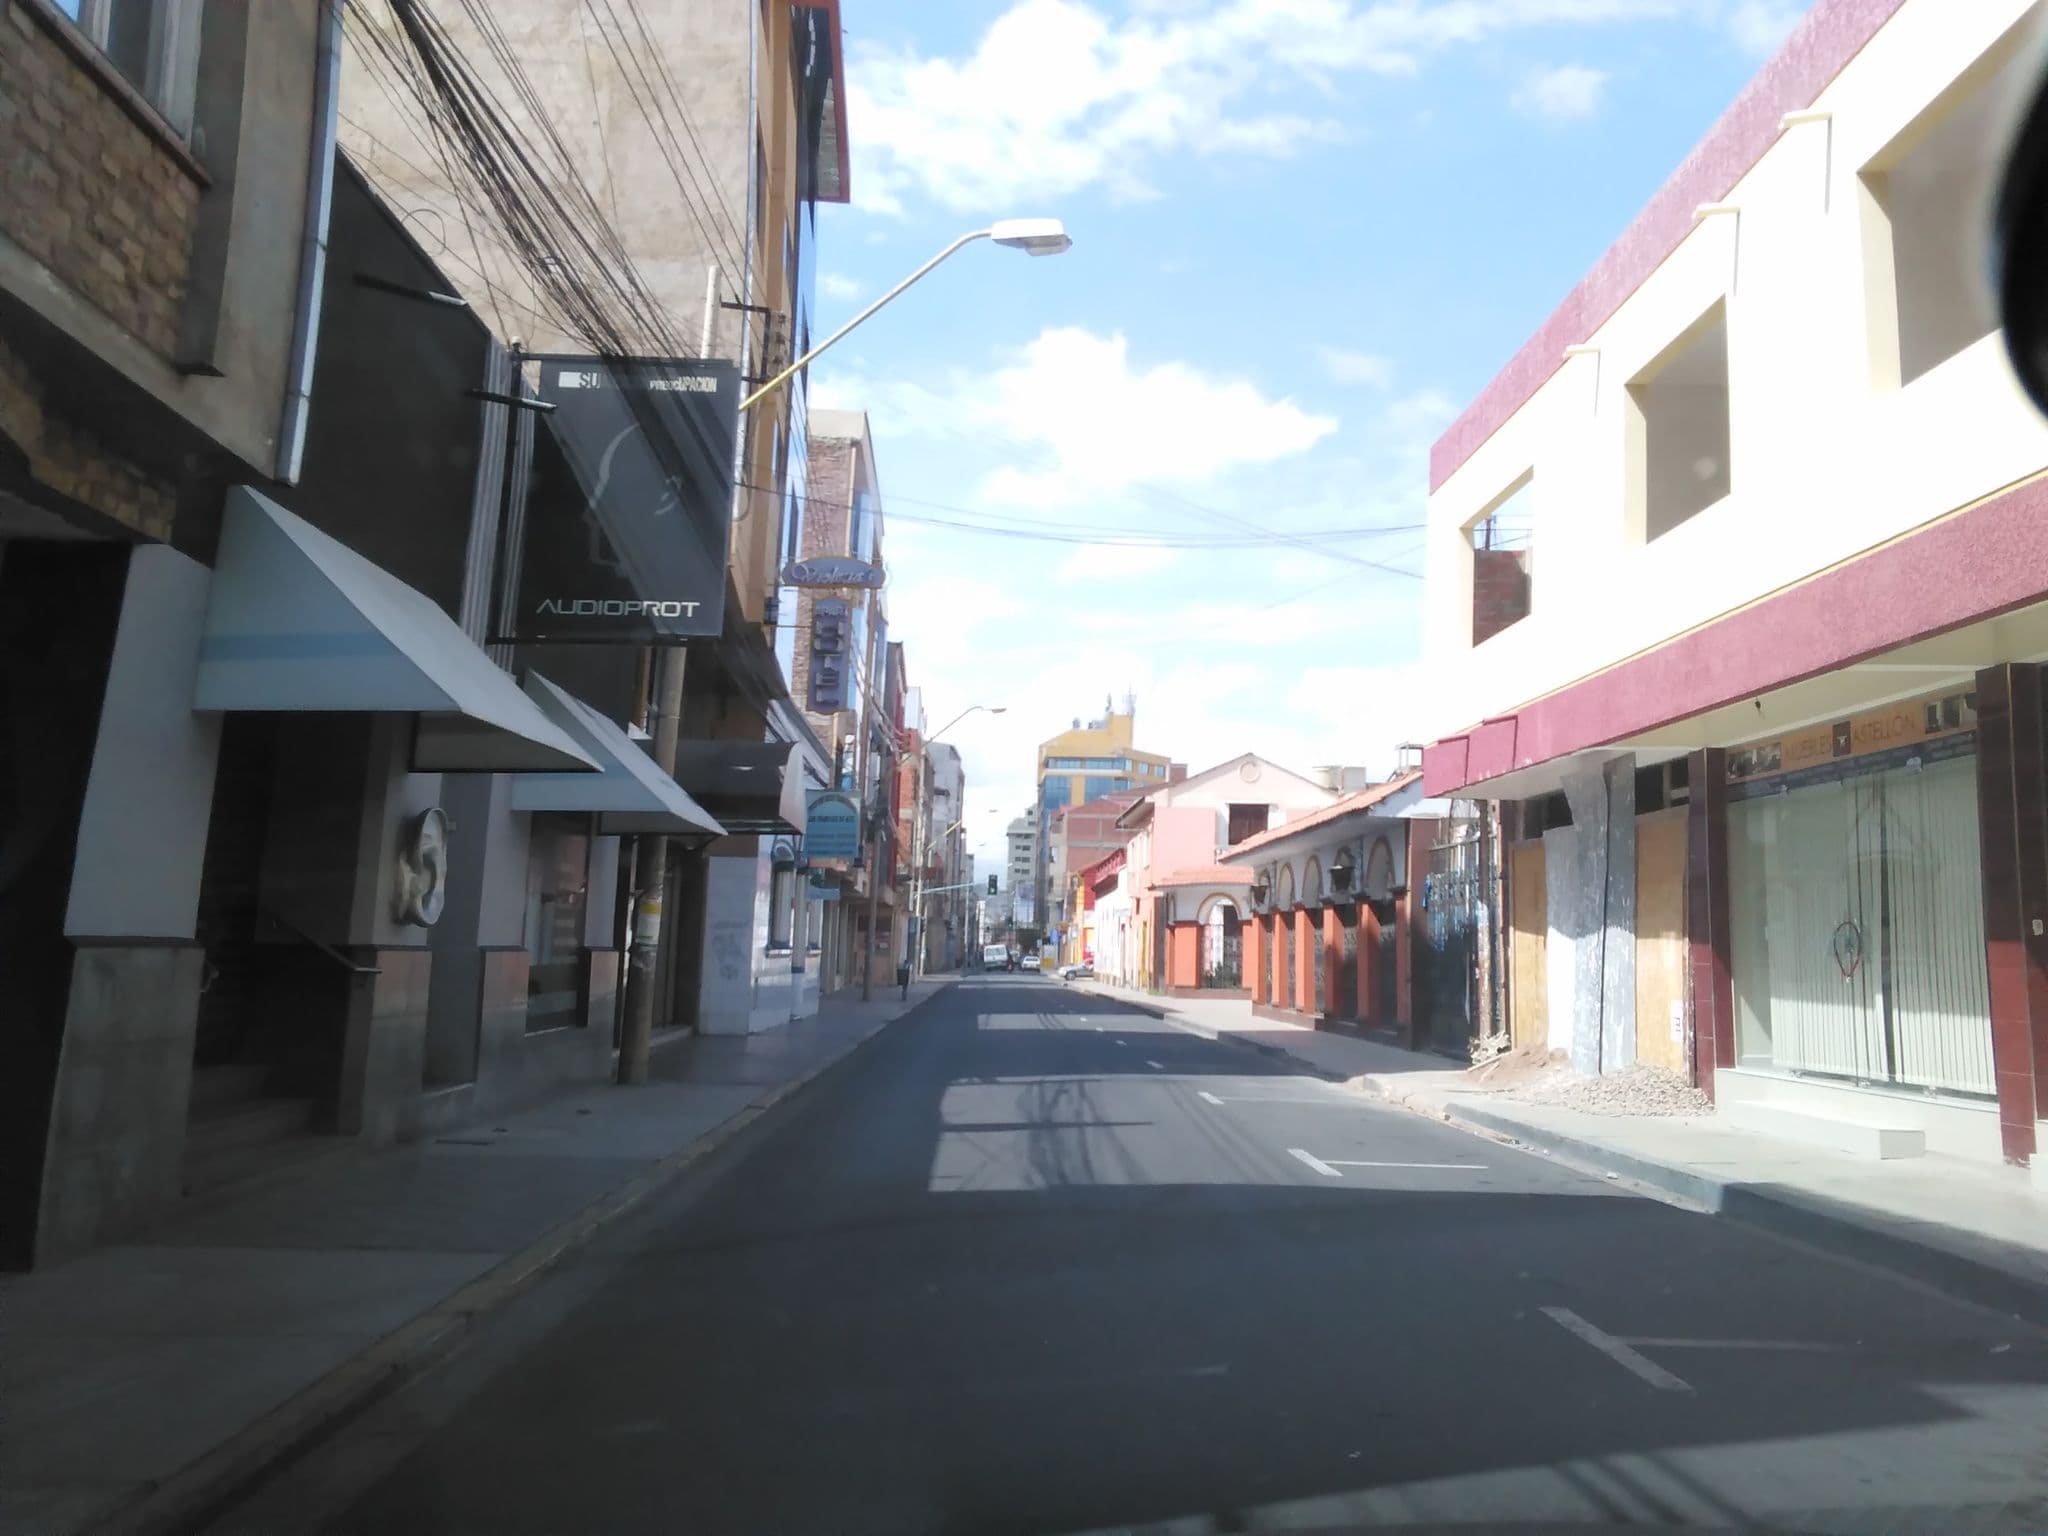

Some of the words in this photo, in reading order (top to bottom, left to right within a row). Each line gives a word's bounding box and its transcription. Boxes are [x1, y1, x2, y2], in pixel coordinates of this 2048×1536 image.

[535, 598, 701, 618] AUDIOPROT
[814, 619, 845, 704] HOTEL
[1783, 734, 1833, 762] MUEBLES
